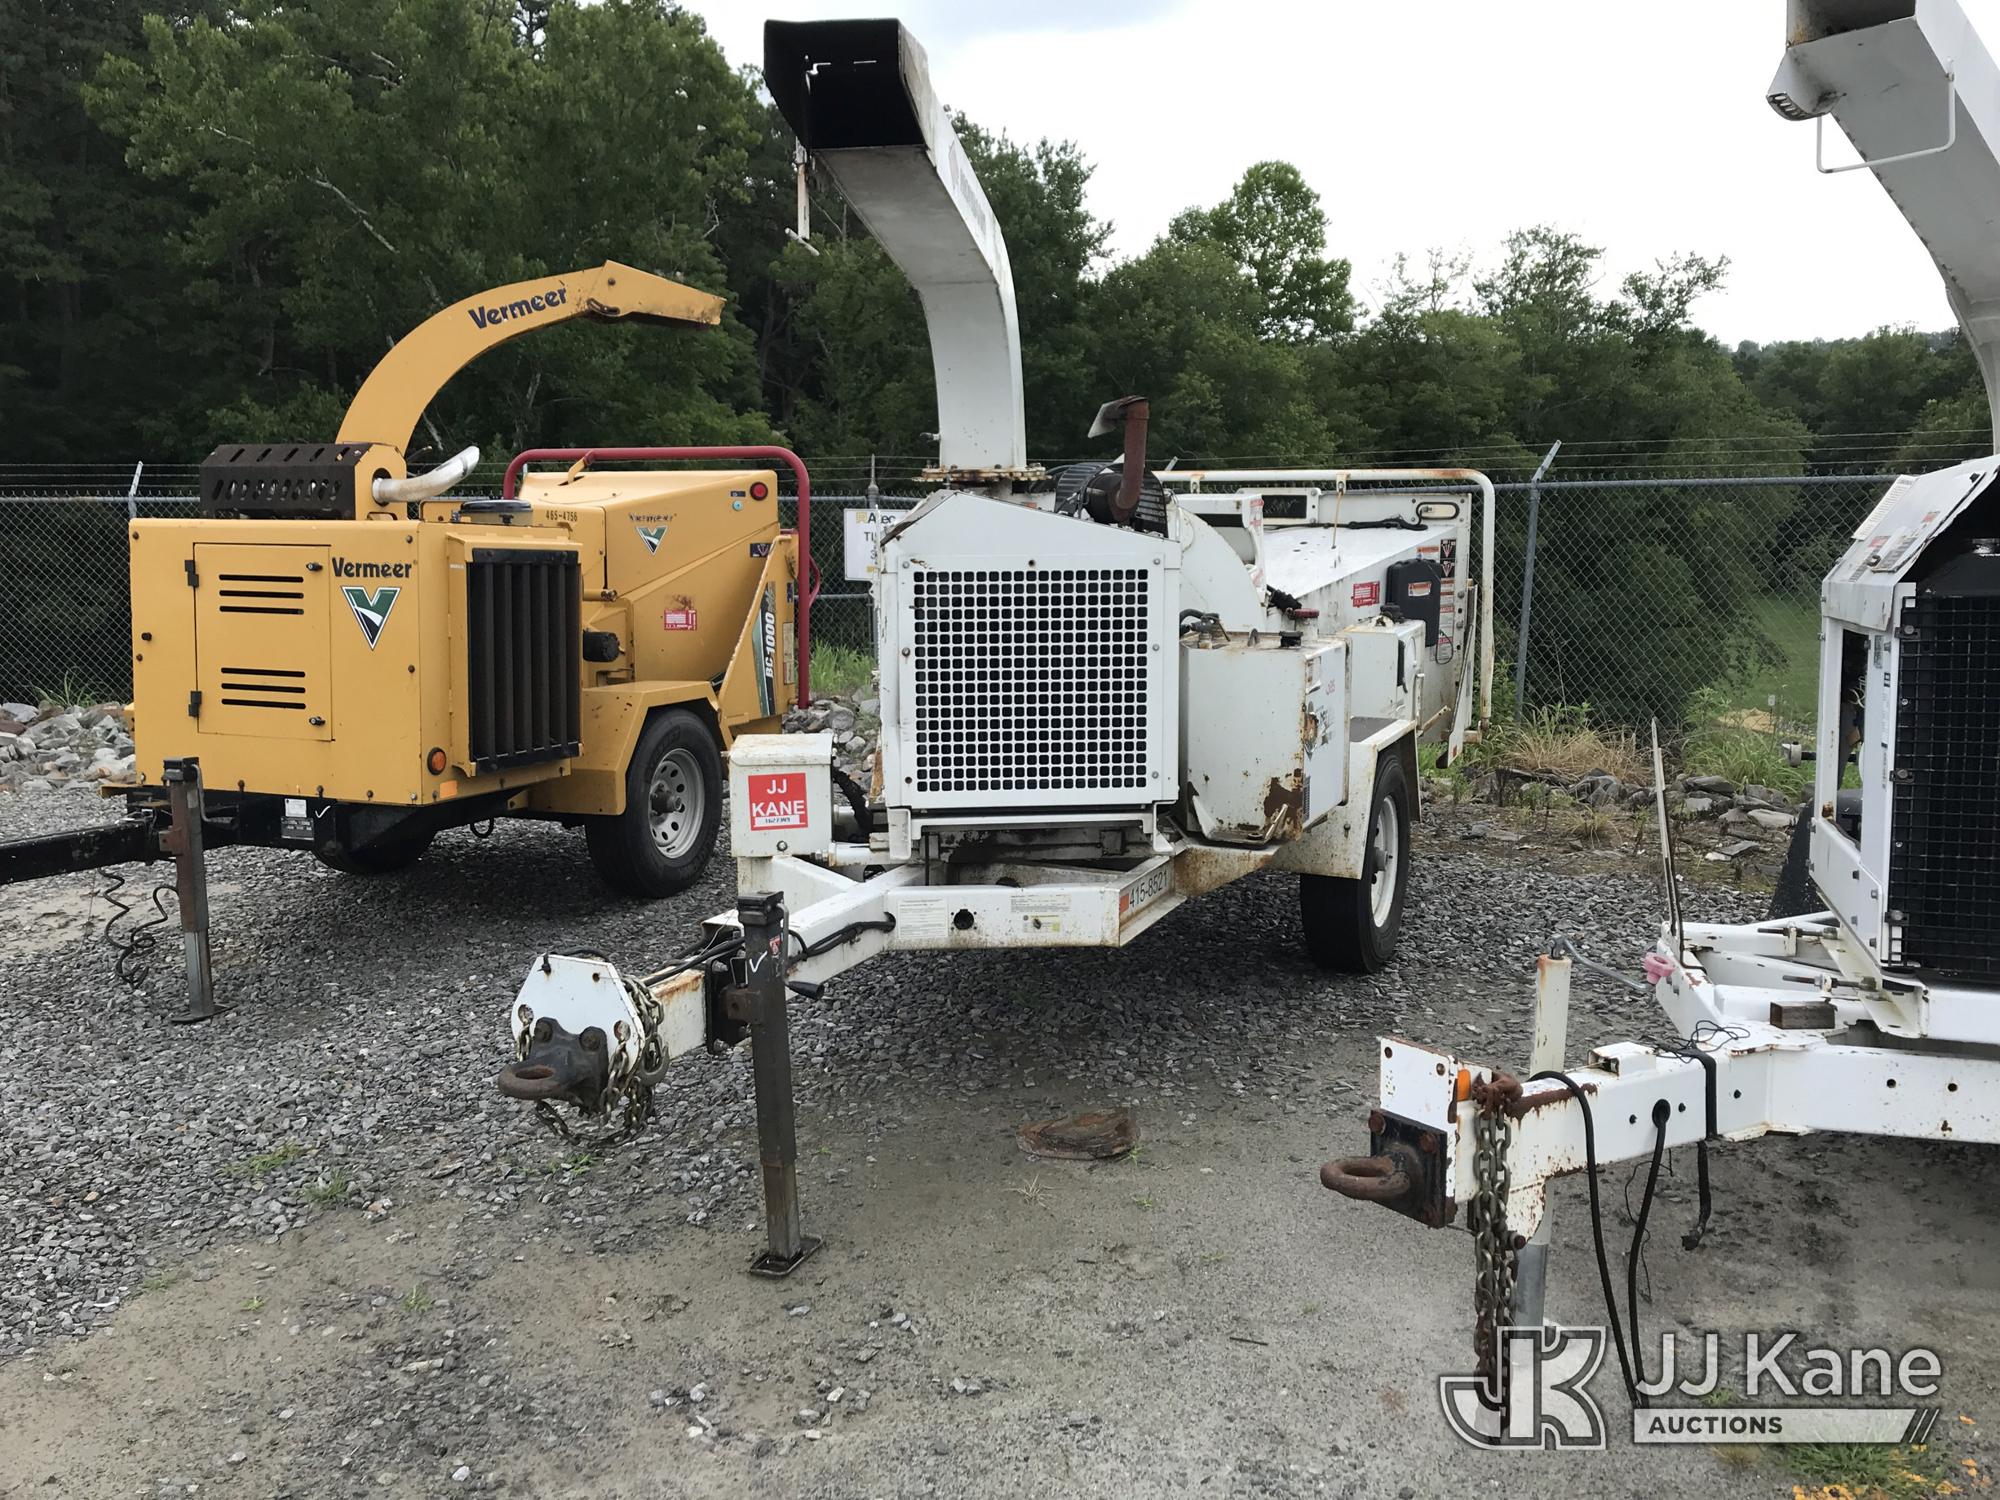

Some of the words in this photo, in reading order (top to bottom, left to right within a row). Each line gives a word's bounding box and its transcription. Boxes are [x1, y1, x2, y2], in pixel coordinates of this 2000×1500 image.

[468, 288, 566, 329] Vermeer
[332, 557, 412, 578] Vermeer
[766, 779, 787, 794] JJ
[752, 800, 806, 817] KANE
[1129, 868, 1167, 908] 415-8521
